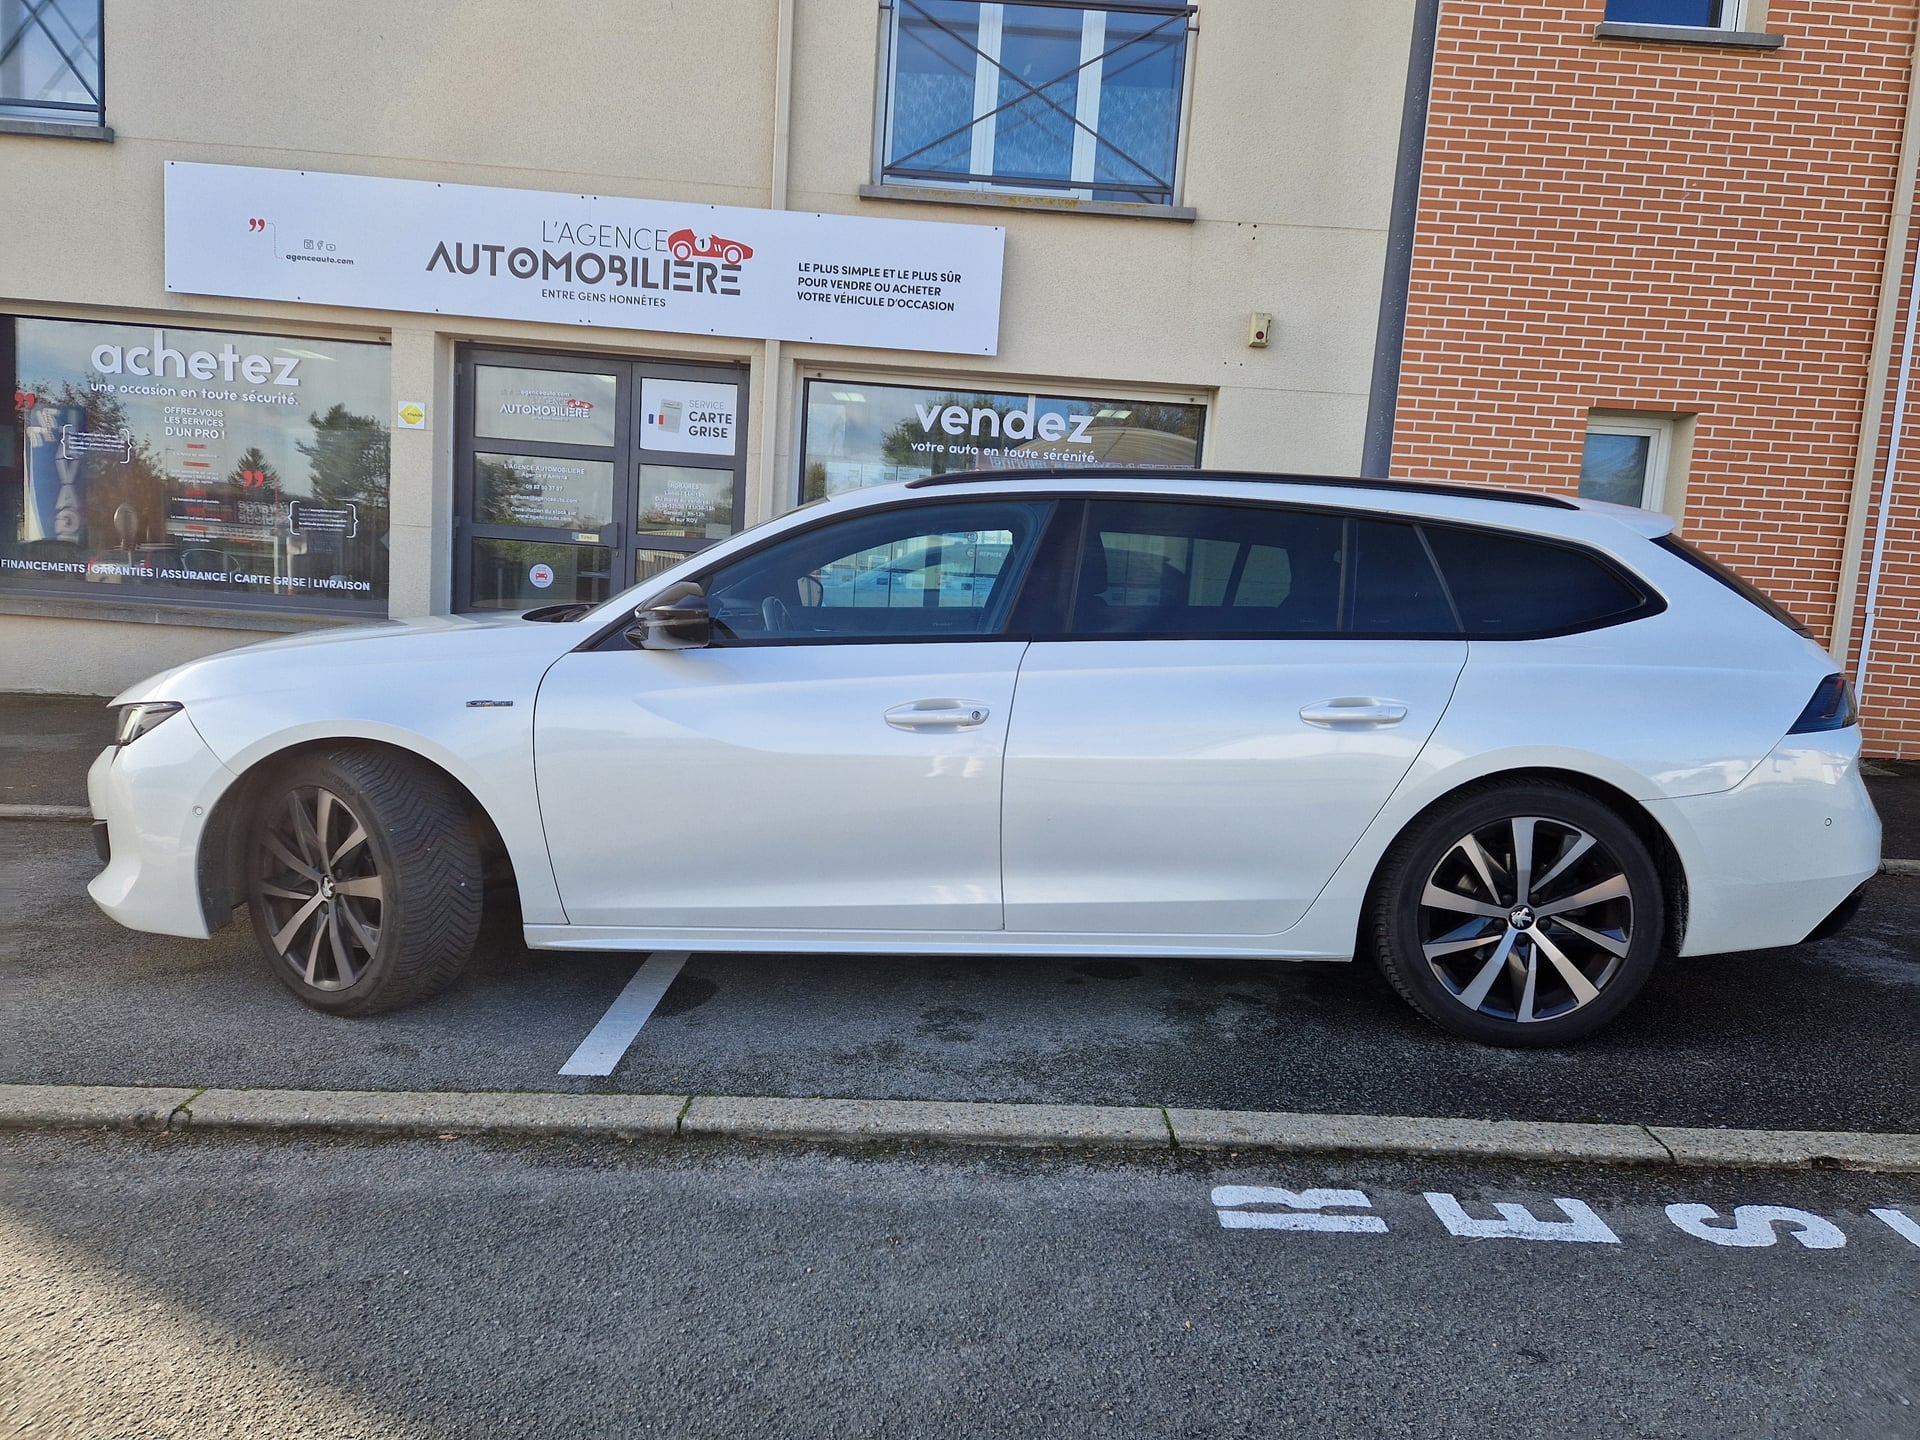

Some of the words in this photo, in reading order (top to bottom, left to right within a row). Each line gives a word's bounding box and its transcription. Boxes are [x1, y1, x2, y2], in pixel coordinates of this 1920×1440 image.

[542, 219, 669, 252] L'AGENCE
[285, 253, 354, 266] agenceauto.com
[798, 262, 811, 272] LE
[812, 263, 839, 275] PLUS
[841, 265, 881, 277] SIMPLE
[883, 268, 896, 279] ET
[897, 269, 909, 280] LE
[911, 270, 938, 282] PLUS
[940, 270, 962, 284] SÛR
[797, 276, 828, 288] POUR
[830, 279, 872, 292] VENDRE
[874, 282, 891, 293] OU
[892, 283, 942, 296] ACHETER
[541, 288, 576, 301] ENTRE
[577, 291, 607, 303] GENS
[609, 292, 667, 307] HONNÊTES
[797, 291, 832, 303] VOTRE
[833, 291, 885, 307] VÉHICULE
[887, 298, 955, 312] D'OCCASION
[91, 330, 300, 386] achetez
[90, 382, 116, 393] une
[120, 383, 176, 397] occasion
[180, 388, 197, 398] en
[201, 387, 238, 402] toute
[242, 390, 300, 406] sécurité.
[164, 406, 224, 417] OFFREZ-VOUS
[689, 400, 724, 410] SERVICE
[164, 416, 180, 424] LES
[182, 417, 224, 427] SERVICES
[689, 411, 732, 424] CARTE
[914, 394, 1095, 444] vendez
[165, 426, 192, 437] D'UN
[195, 428, 219, 439] PRO
[689, 425, 728, 438] GRISE
[911, 441, 945, 453] votre
[949, 443, 979, 455] auto
[983, 447, 999, 457] en
[1003, 446, 1039, 459] toute
[1043, 448, 1099, 464] sérénité.
[0, 558, 86, 574] FINANCEMENTS
[91, 565, 153, 578] GARANTIES
[160, 569, 227, 582] ASSURANCE
[234, 573, 271, 585] CARTE
[272, 576, 306, 587] GRISE
[313, 579, 371, 591] LIVRAISON
